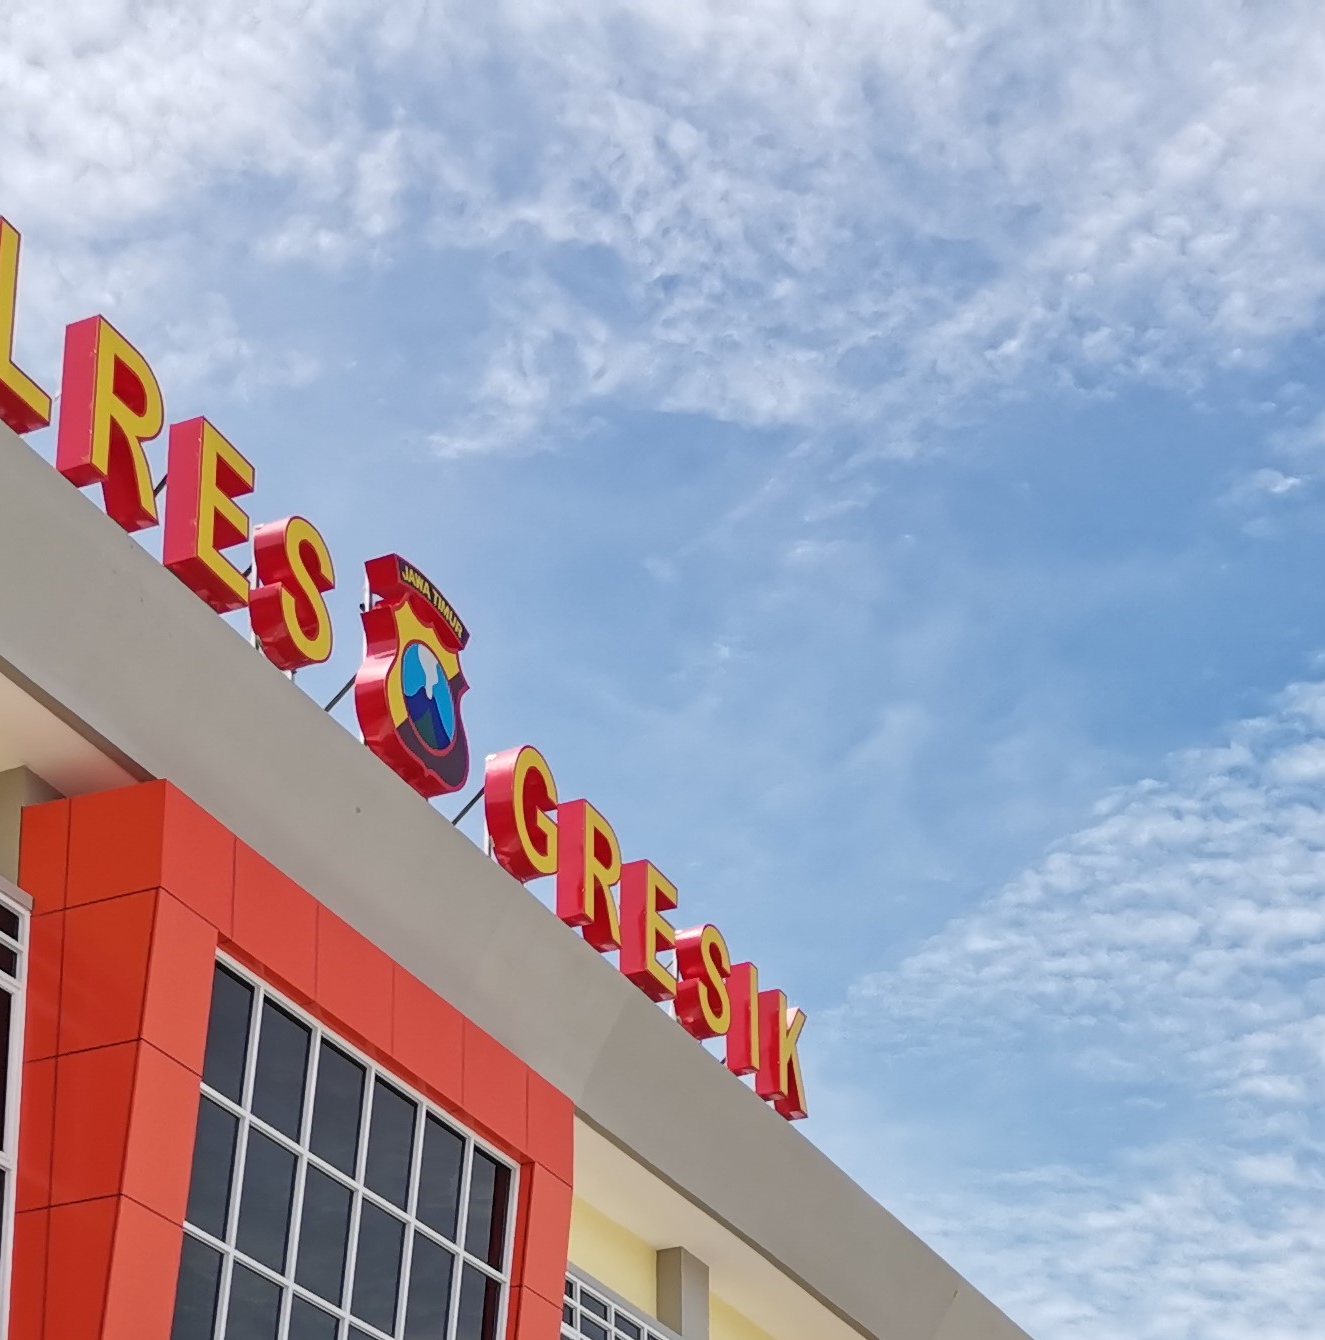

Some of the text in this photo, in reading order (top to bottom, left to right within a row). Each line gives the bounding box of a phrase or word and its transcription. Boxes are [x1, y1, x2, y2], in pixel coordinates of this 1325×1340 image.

[402, 565, 463, 639] JAWA TIMUR
[485, 745, 808, 1121] GRESIK
